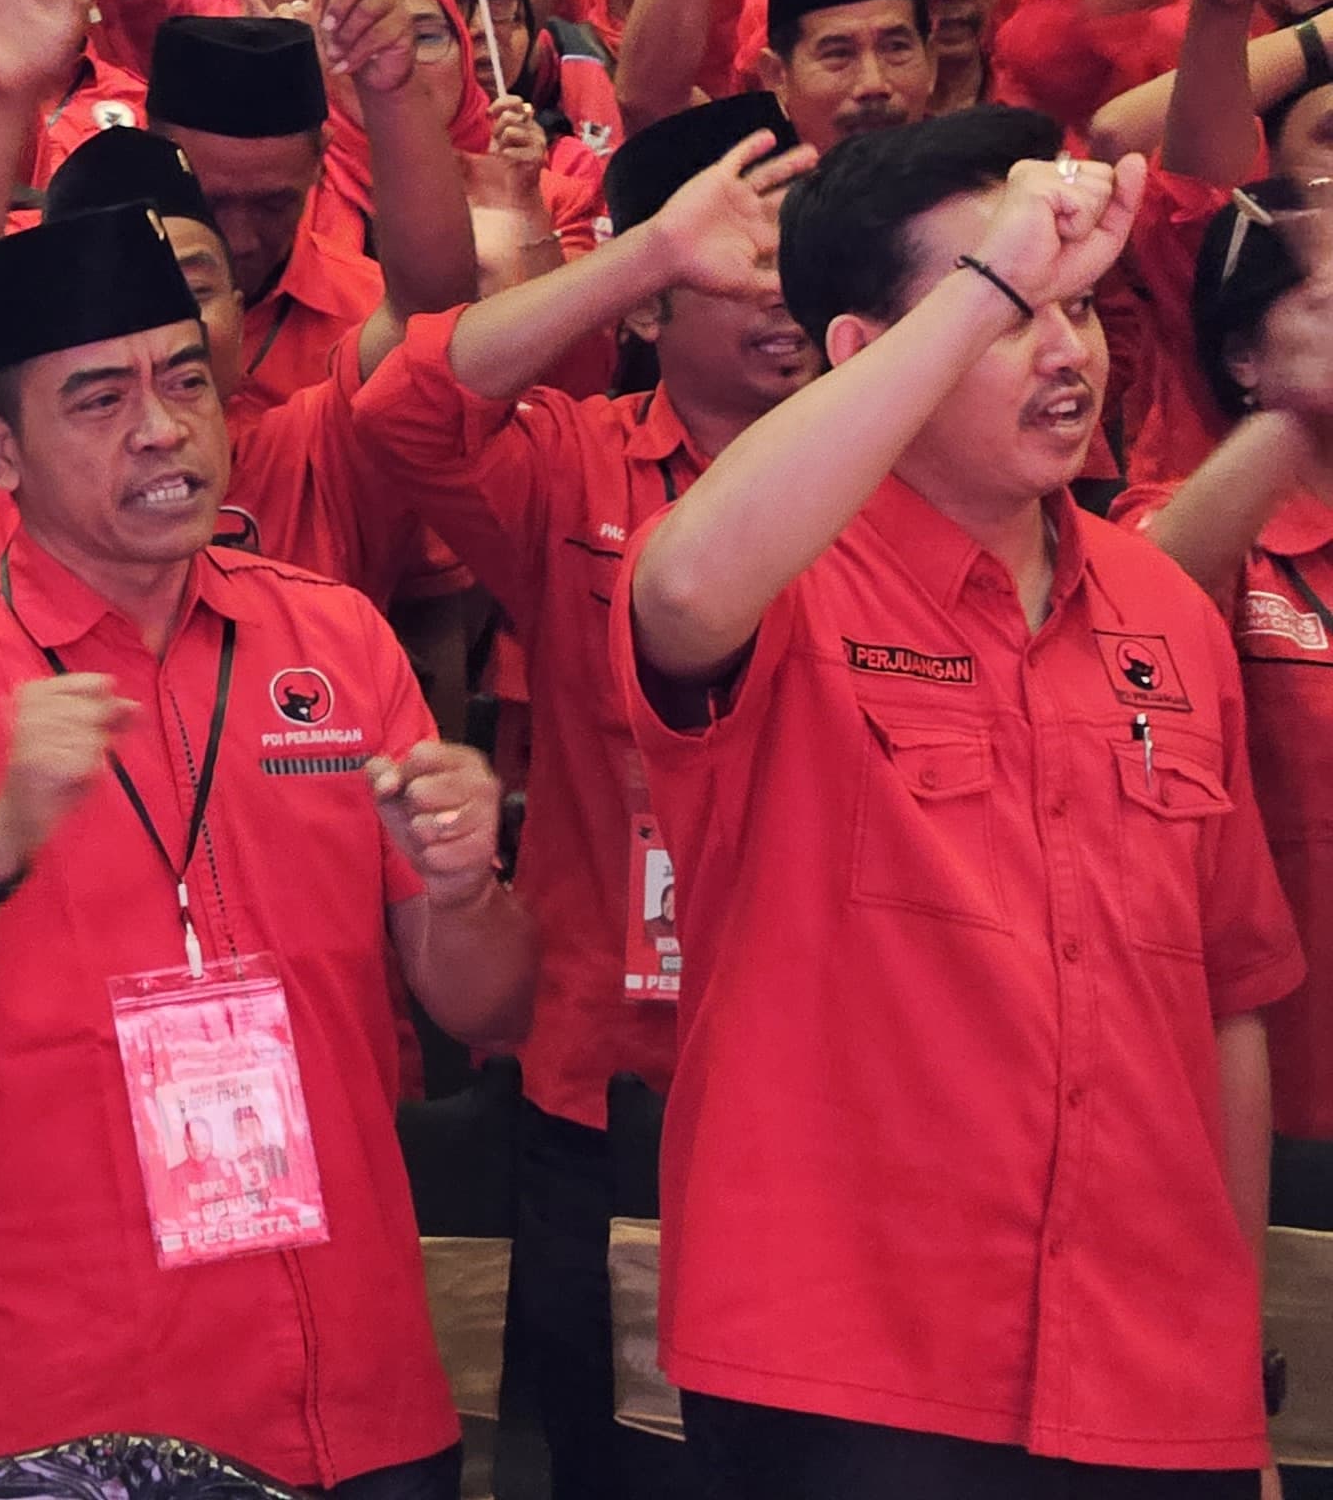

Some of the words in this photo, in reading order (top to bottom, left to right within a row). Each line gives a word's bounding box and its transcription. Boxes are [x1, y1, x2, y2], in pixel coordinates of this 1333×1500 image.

[856, 648, 972, 682] PERJUANGAN
[260, 733, 284, 747] PDI
[188, 1215, 296, 1246] PESERTA
